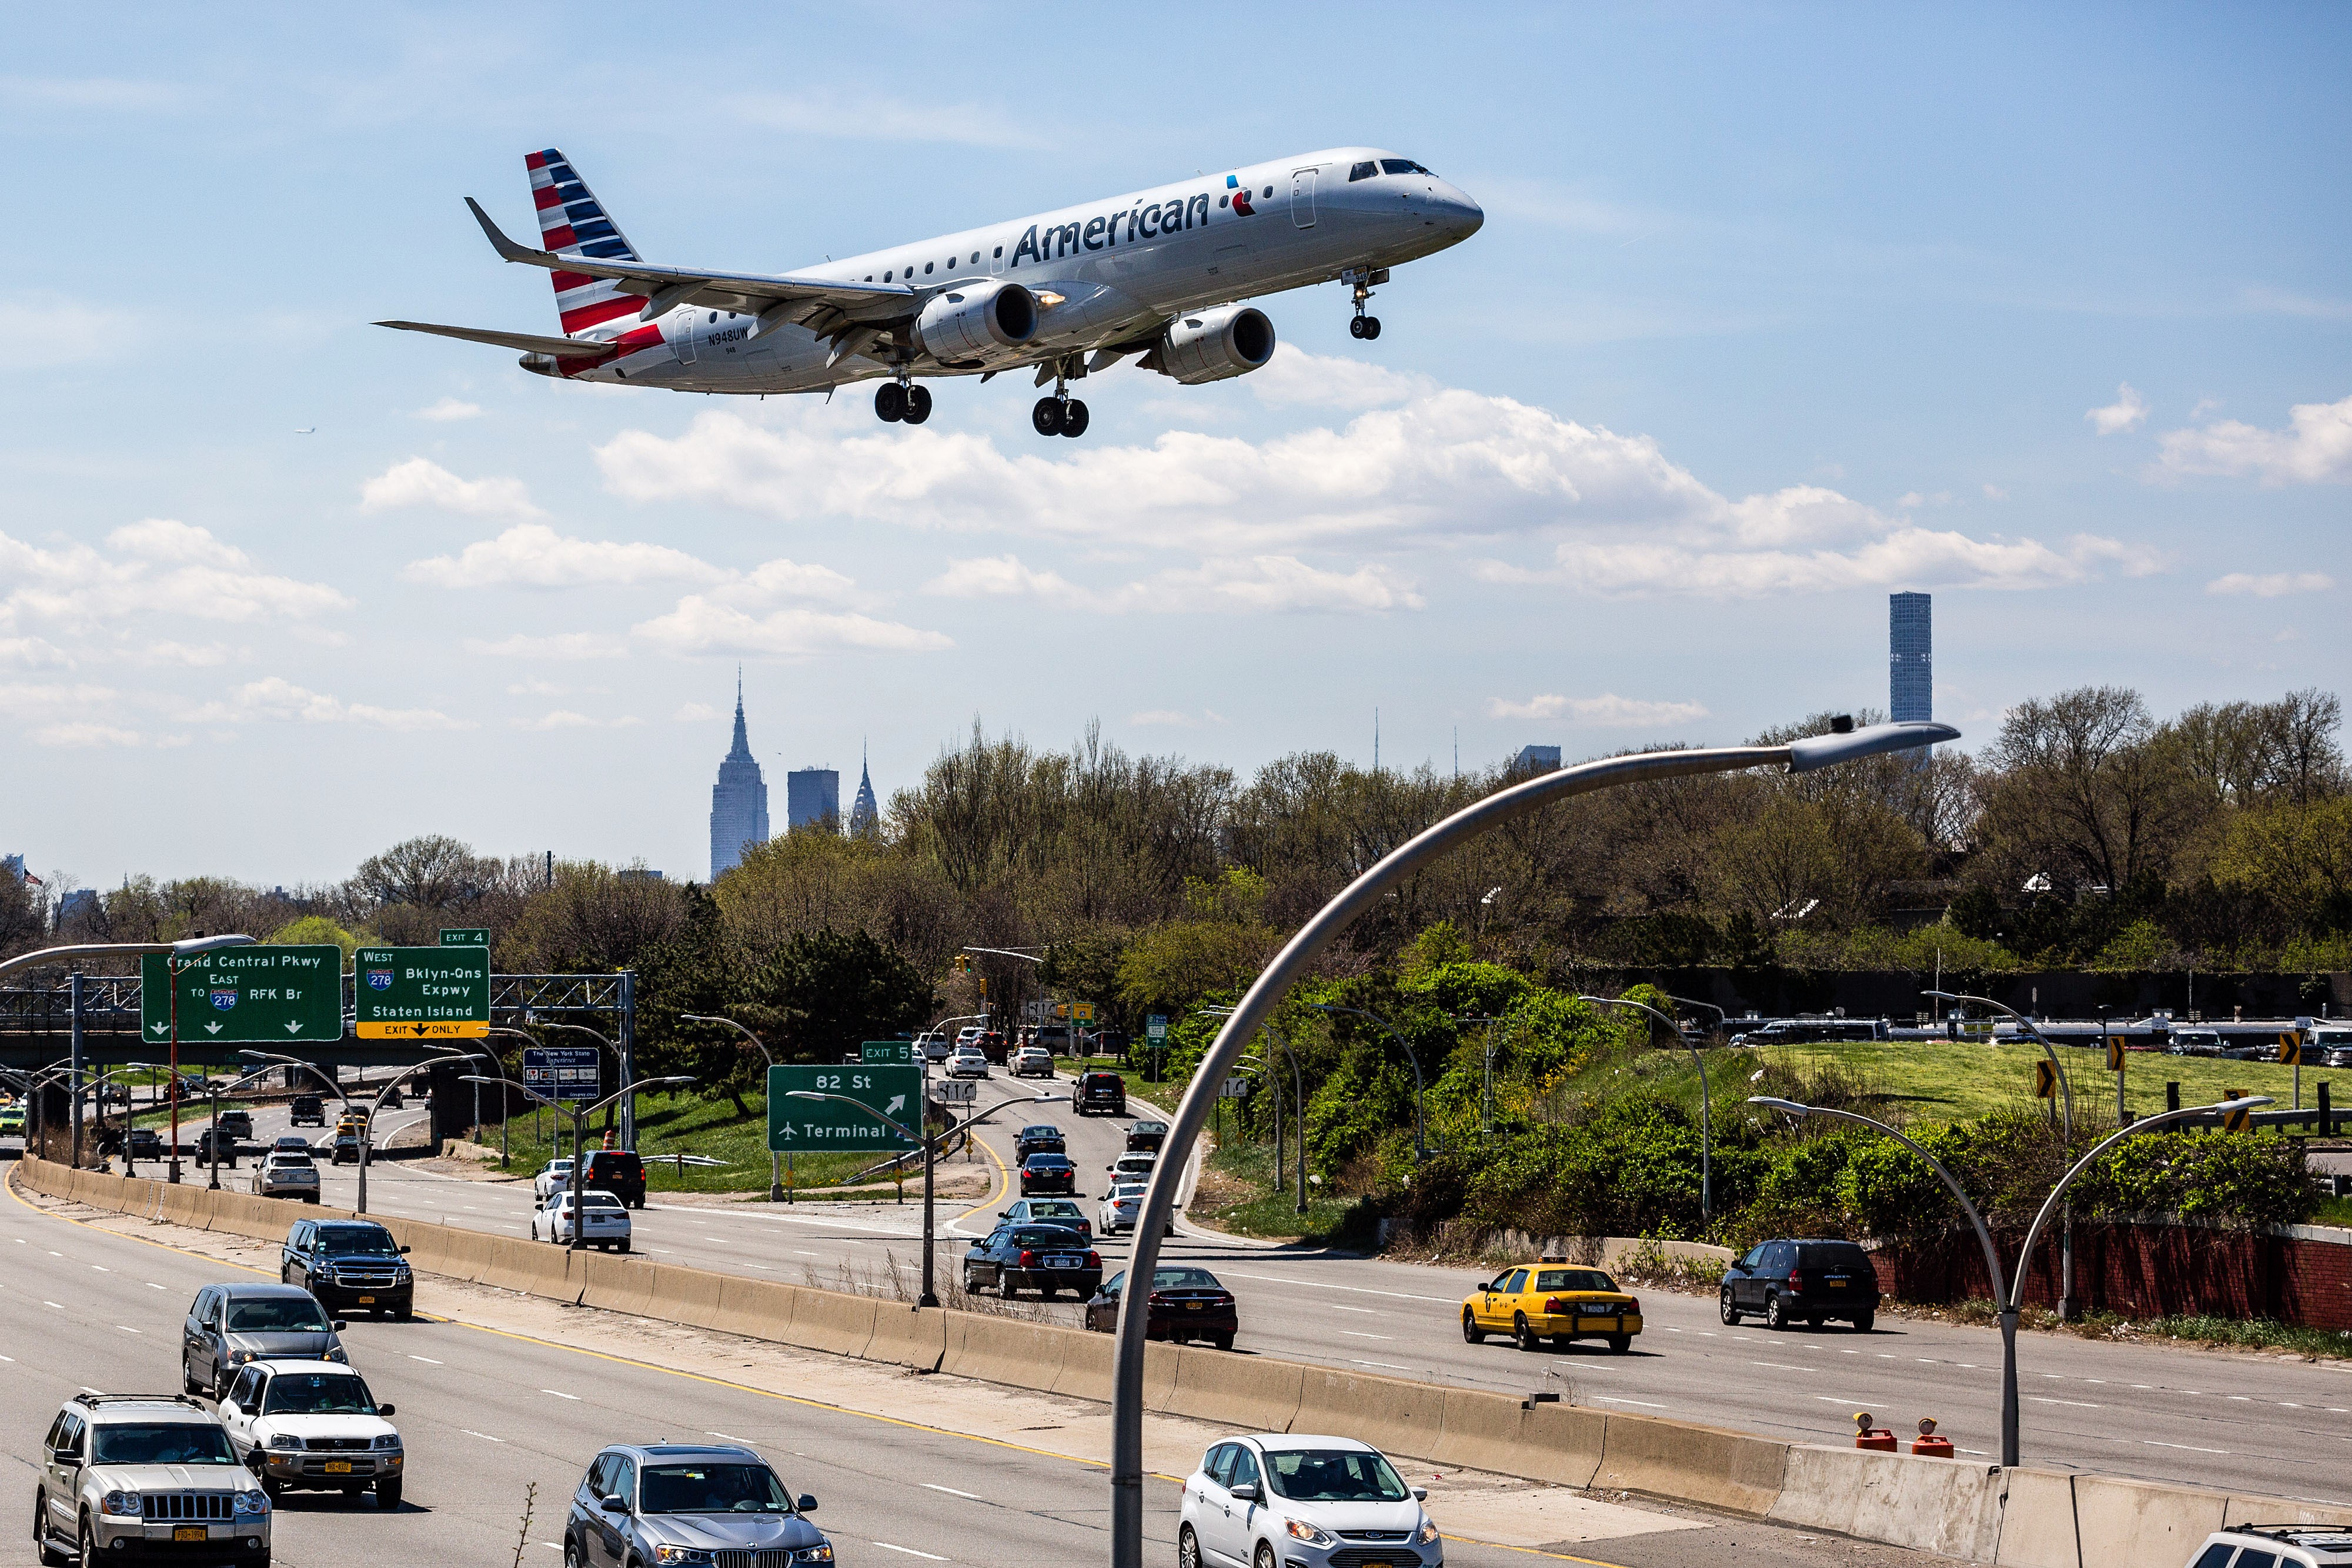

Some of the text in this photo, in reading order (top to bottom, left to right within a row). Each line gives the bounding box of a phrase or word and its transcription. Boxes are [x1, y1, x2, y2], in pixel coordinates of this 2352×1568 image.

[1010, 193, 1210, 268] American
[1355, 273, 1368, 282] 948
[708, 326, 748, 346] N948UW
[474, 932, 483, 942] 4
[219, 956, 275, 967] Central
[282, 956, 320, 968] Pkwy
[363, 952, 393, 962] WEST
[210, 974, 239, 984] EAST
[371, 975, 391, 985] 278
[406, 968, 482, 981] Bklyn-Qns
[191, 989, 204, 997] TO
[250, 989, 302, 999] RFK Br
[422, 984, 470, 997] Expwy
[215, 995, 235, 1005] 278
[373, 1005, 473, 1017] Staten Island
[385, 1025, 460, 1034] EXIT ONLY
[866, 1047, 908, 1059] EXIT 5
[816, 1075, 871, 1089] 82 St
[804, 1124, 886, 1138] Terminal
